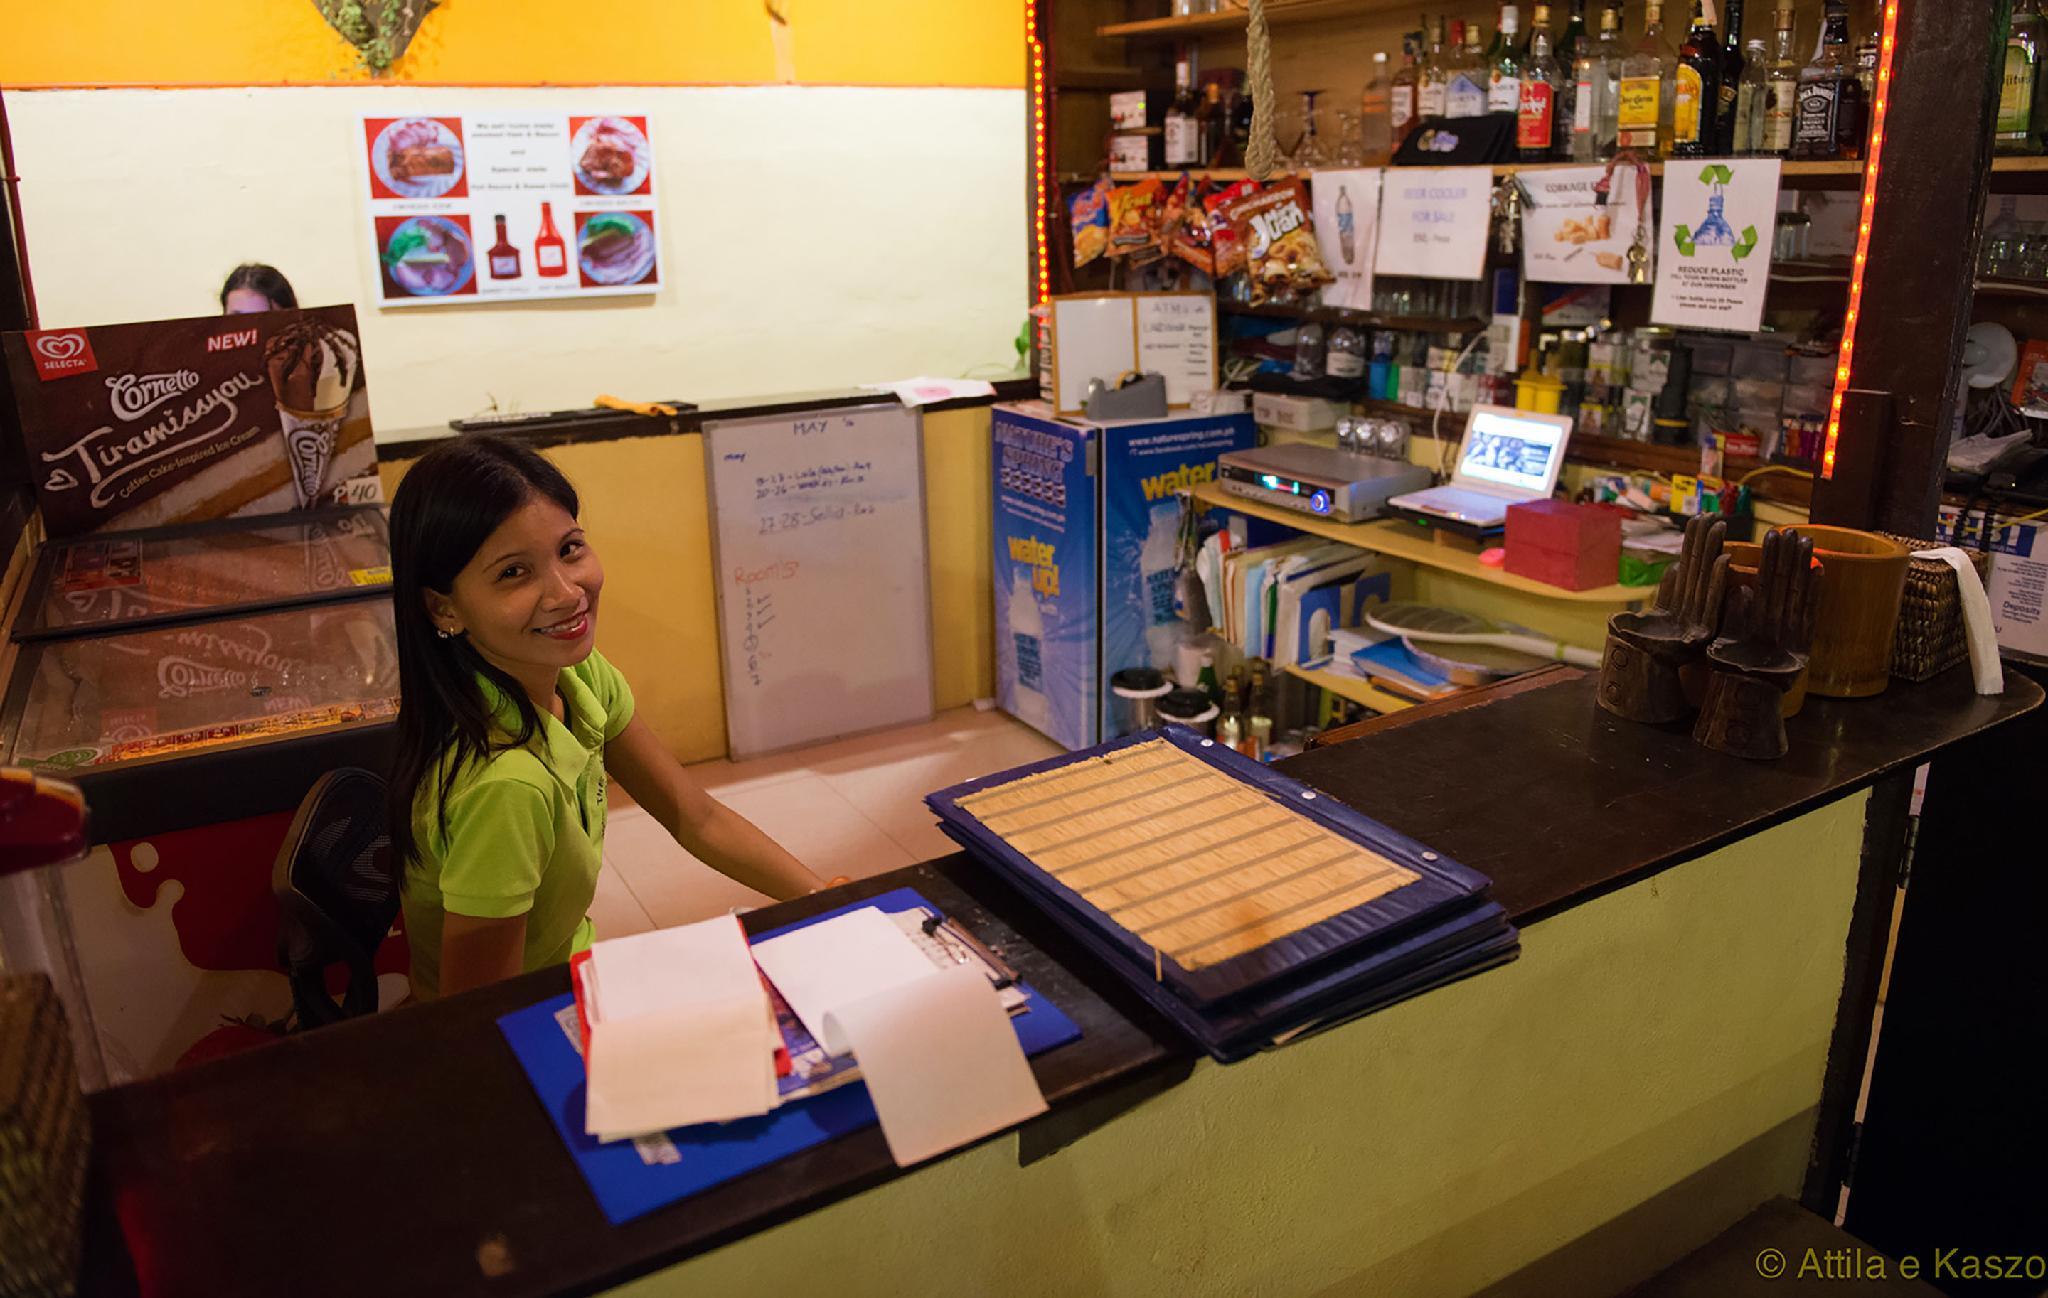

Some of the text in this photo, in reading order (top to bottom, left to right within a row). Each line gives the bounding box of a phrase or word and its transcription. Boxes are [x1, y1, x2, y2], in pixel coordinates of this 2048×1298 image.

[1677, 265, 1745, 277] REDUCE PLASTIC
[207, 328, 258, 352] NEW!
[43, 358, 86, 370] SELECTA
[105, 368, 200, 422] Cornetto
[793, 420, 828, 436] MAY
[1141, 460, 1216, 501] water
[1007, 534, 1056, 566] water
[1032, 563, 1061, 600] up!
[2002, 600, 2041, 617] Deposits
